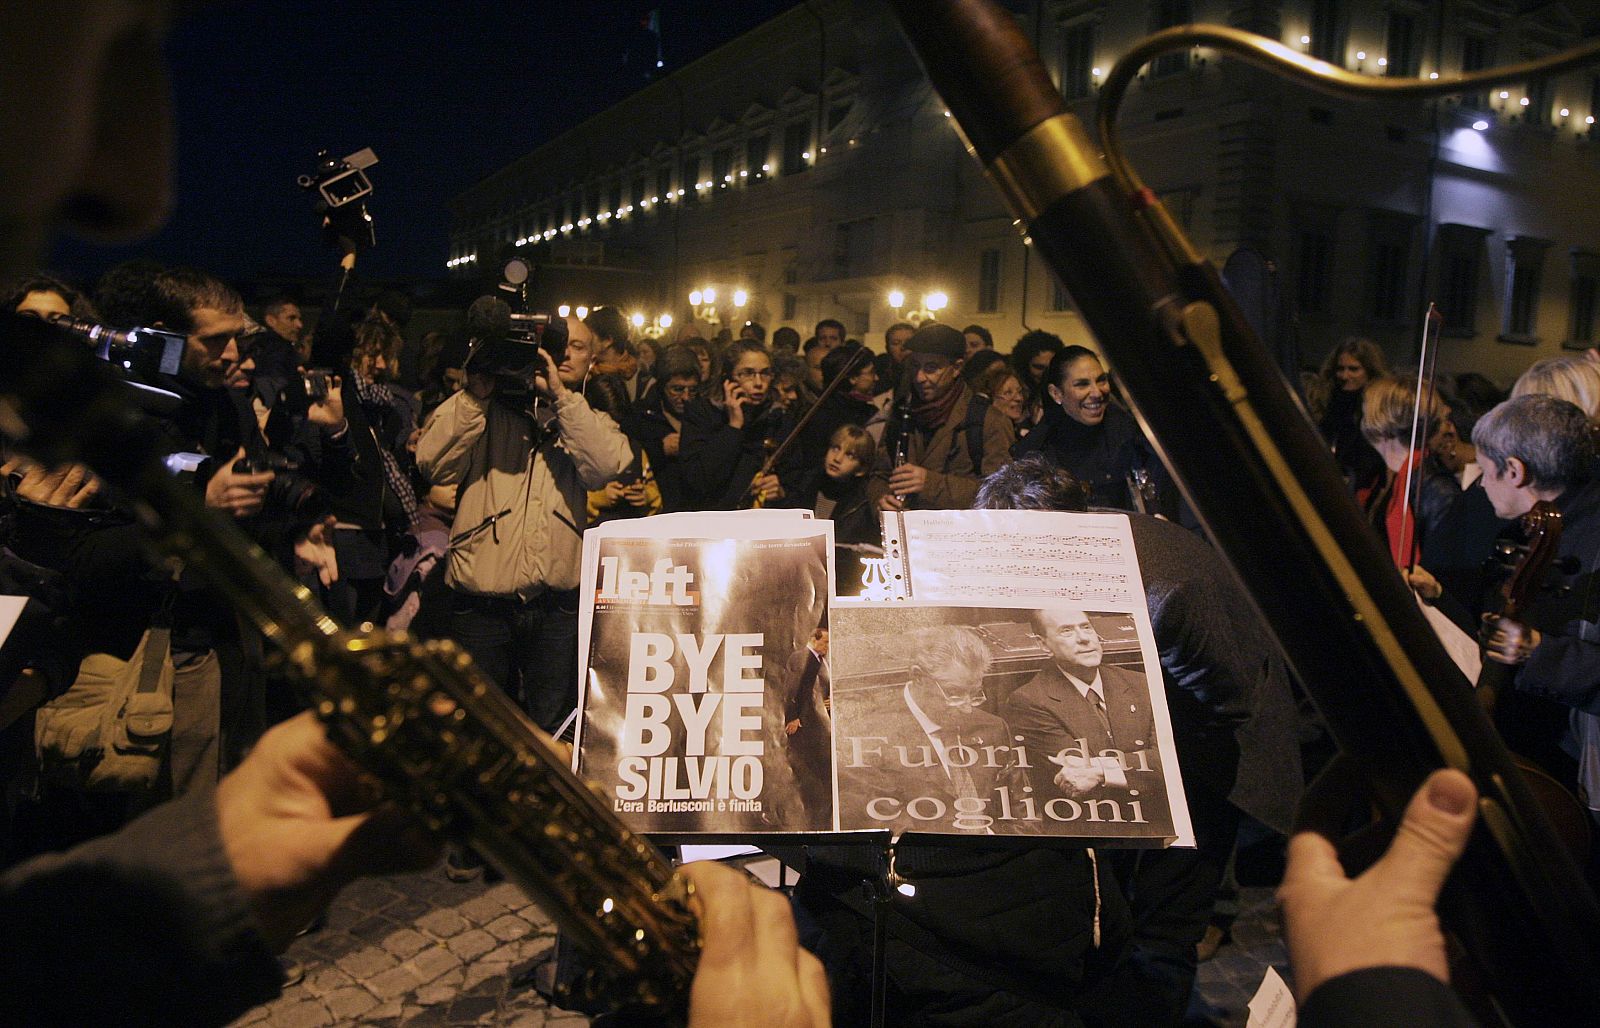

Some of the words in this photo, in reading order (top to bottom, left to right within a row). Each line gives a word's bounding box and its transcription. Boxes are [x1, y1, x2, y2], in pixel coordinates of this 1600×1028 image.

[598, 556, 694, 606] left
[627, 632, 765, 693] BYE
[623, 692, 765, 757] BYE
[844, 735, 1034, 769] Fuori
[1055, 737, 1154, 773] dai
[615, 756, 764, 800] SILVIO
[614, 800, 644, 813] L'era
[648, 799, 714, 813] Berlusconi
[718, 799, 726, 812] è
[729, 799, 762, 813] finita
[866, 785, 1150, 831] coglioni
